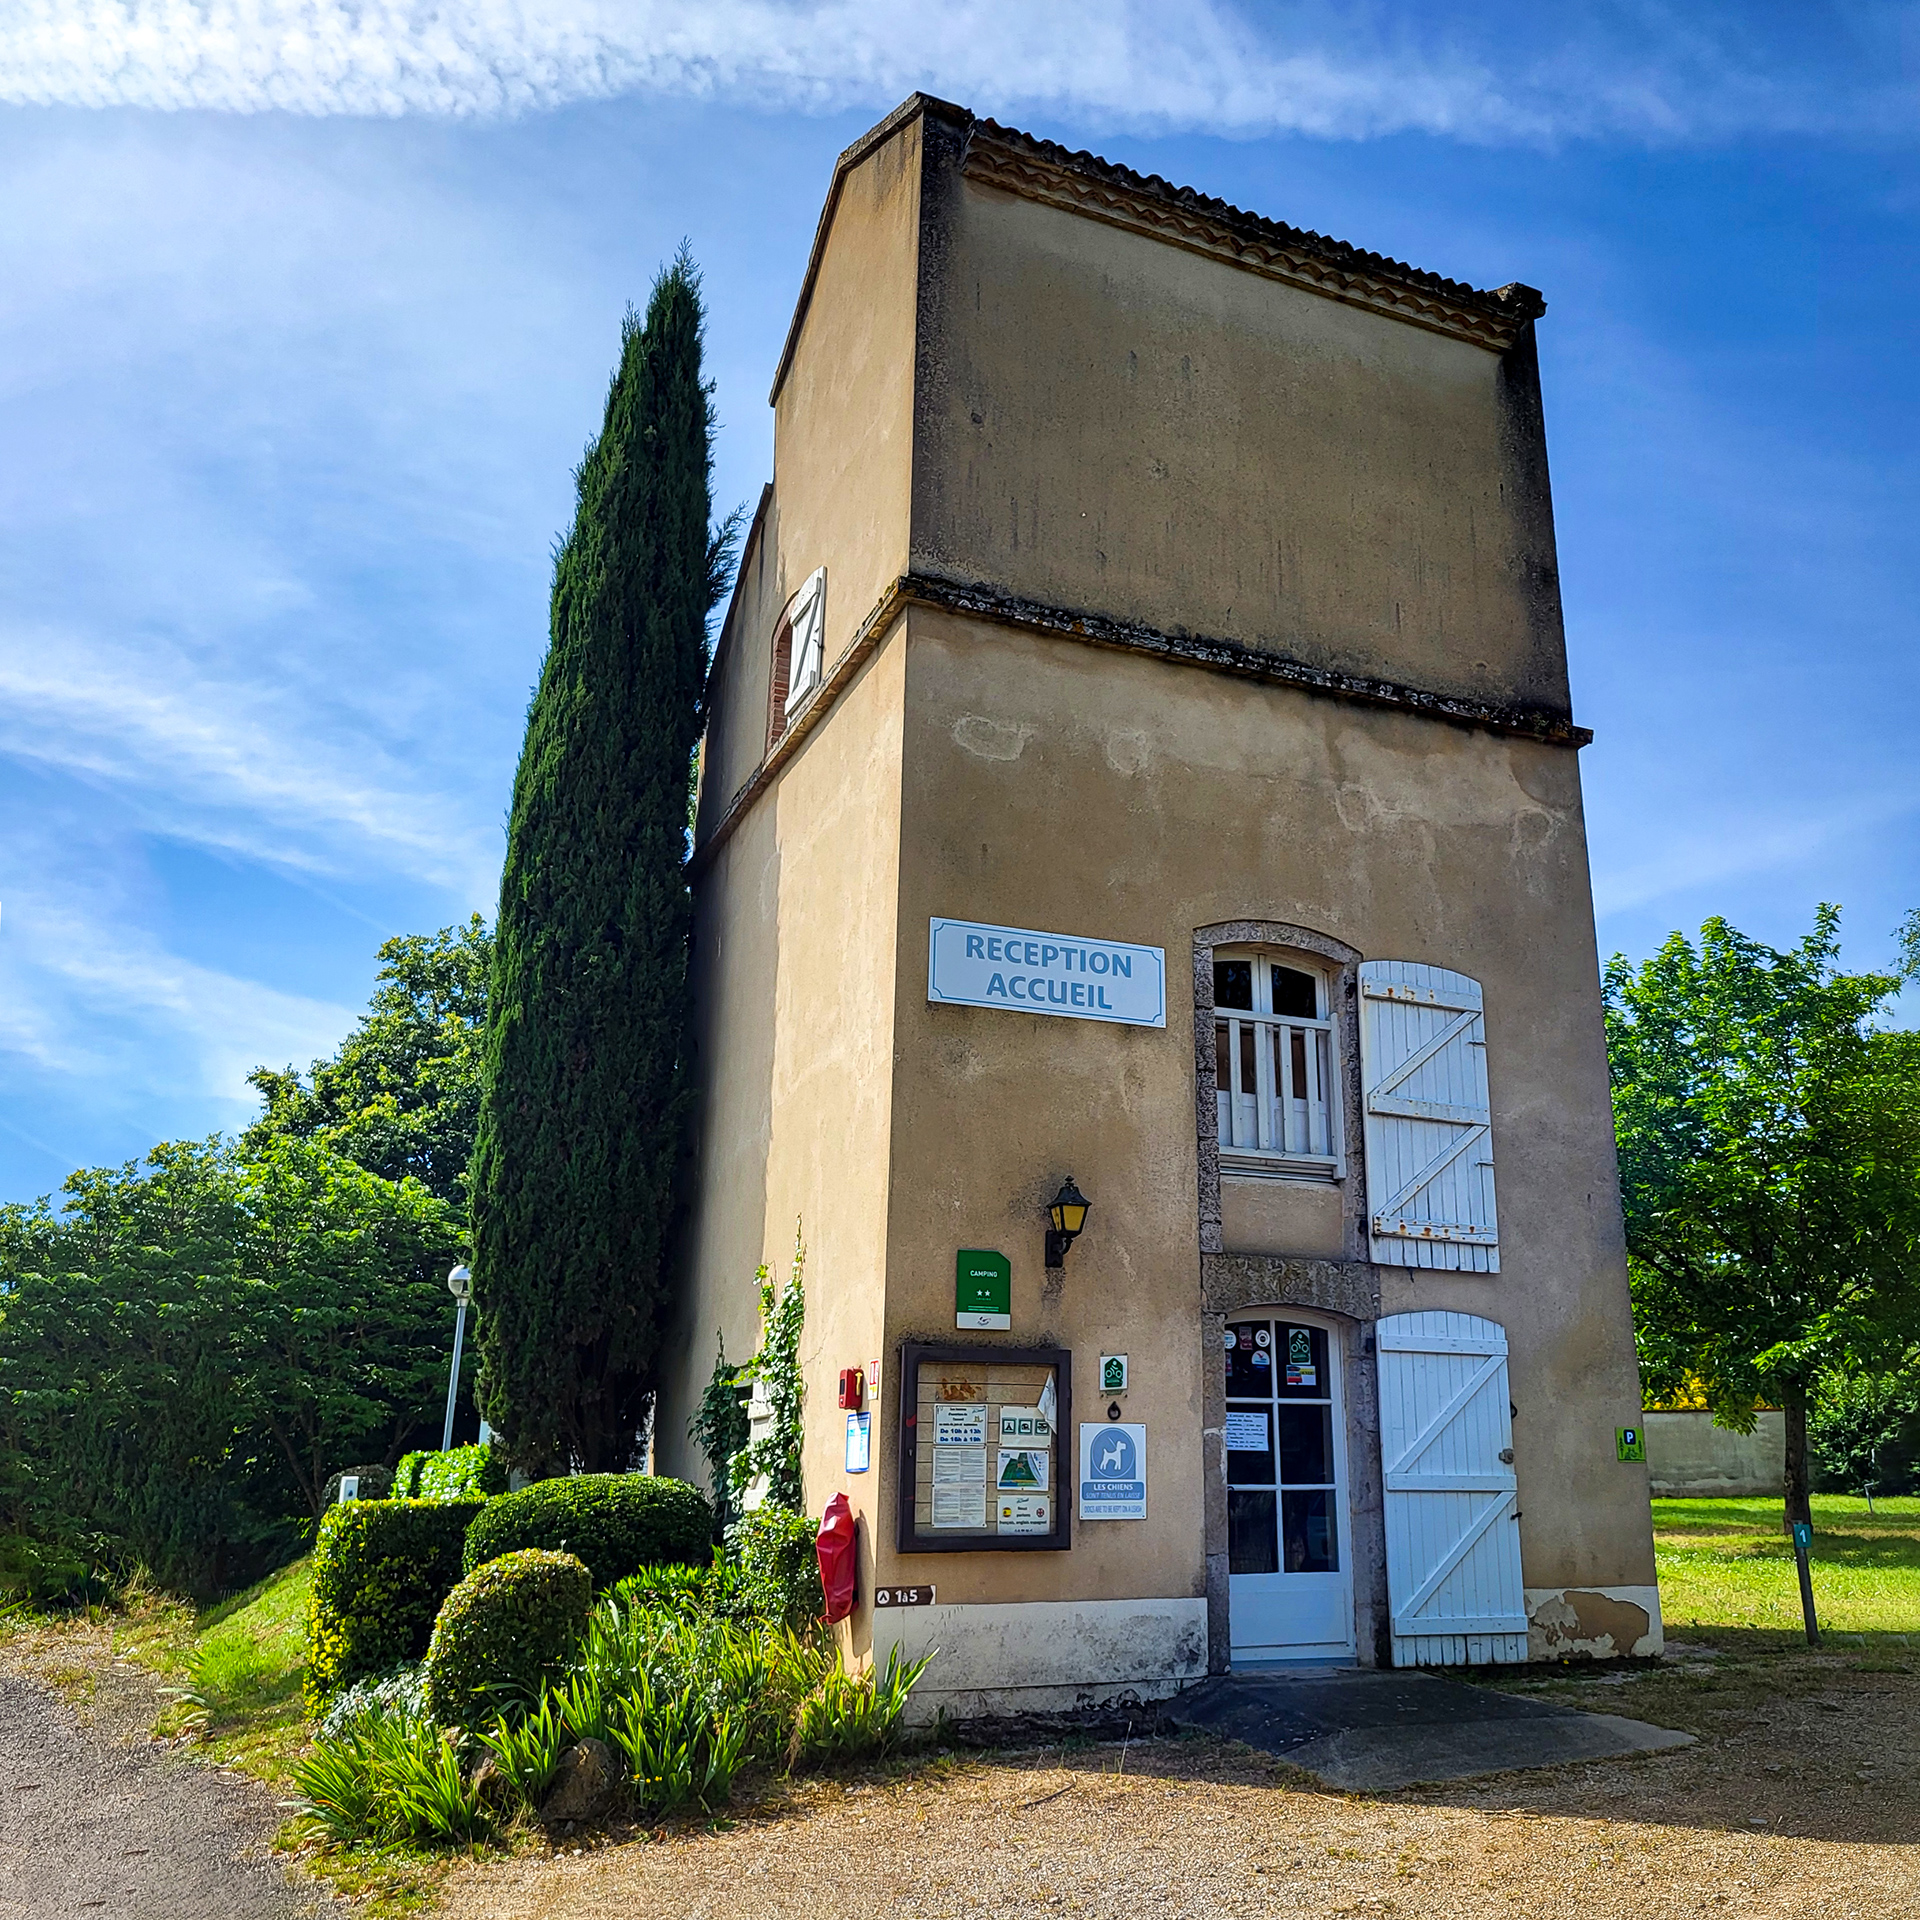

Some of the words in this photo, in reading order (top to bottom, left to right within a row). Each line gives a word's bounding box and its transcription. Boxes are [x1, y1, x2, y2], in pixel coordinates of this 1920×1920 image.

[966, 934, 1132, 978] RECEPTION
[986, 973, 1112, 1010] ACCUEIL
[970, 1270, 998, 1278] CAMPING
[1626, 1431, 1634, 1443] P
[1093, 1483, 1106, 1491] LES
[1107, 1483, 1134, 1491] CHIENS
[1800, 1529, 1806, 1543] 1
